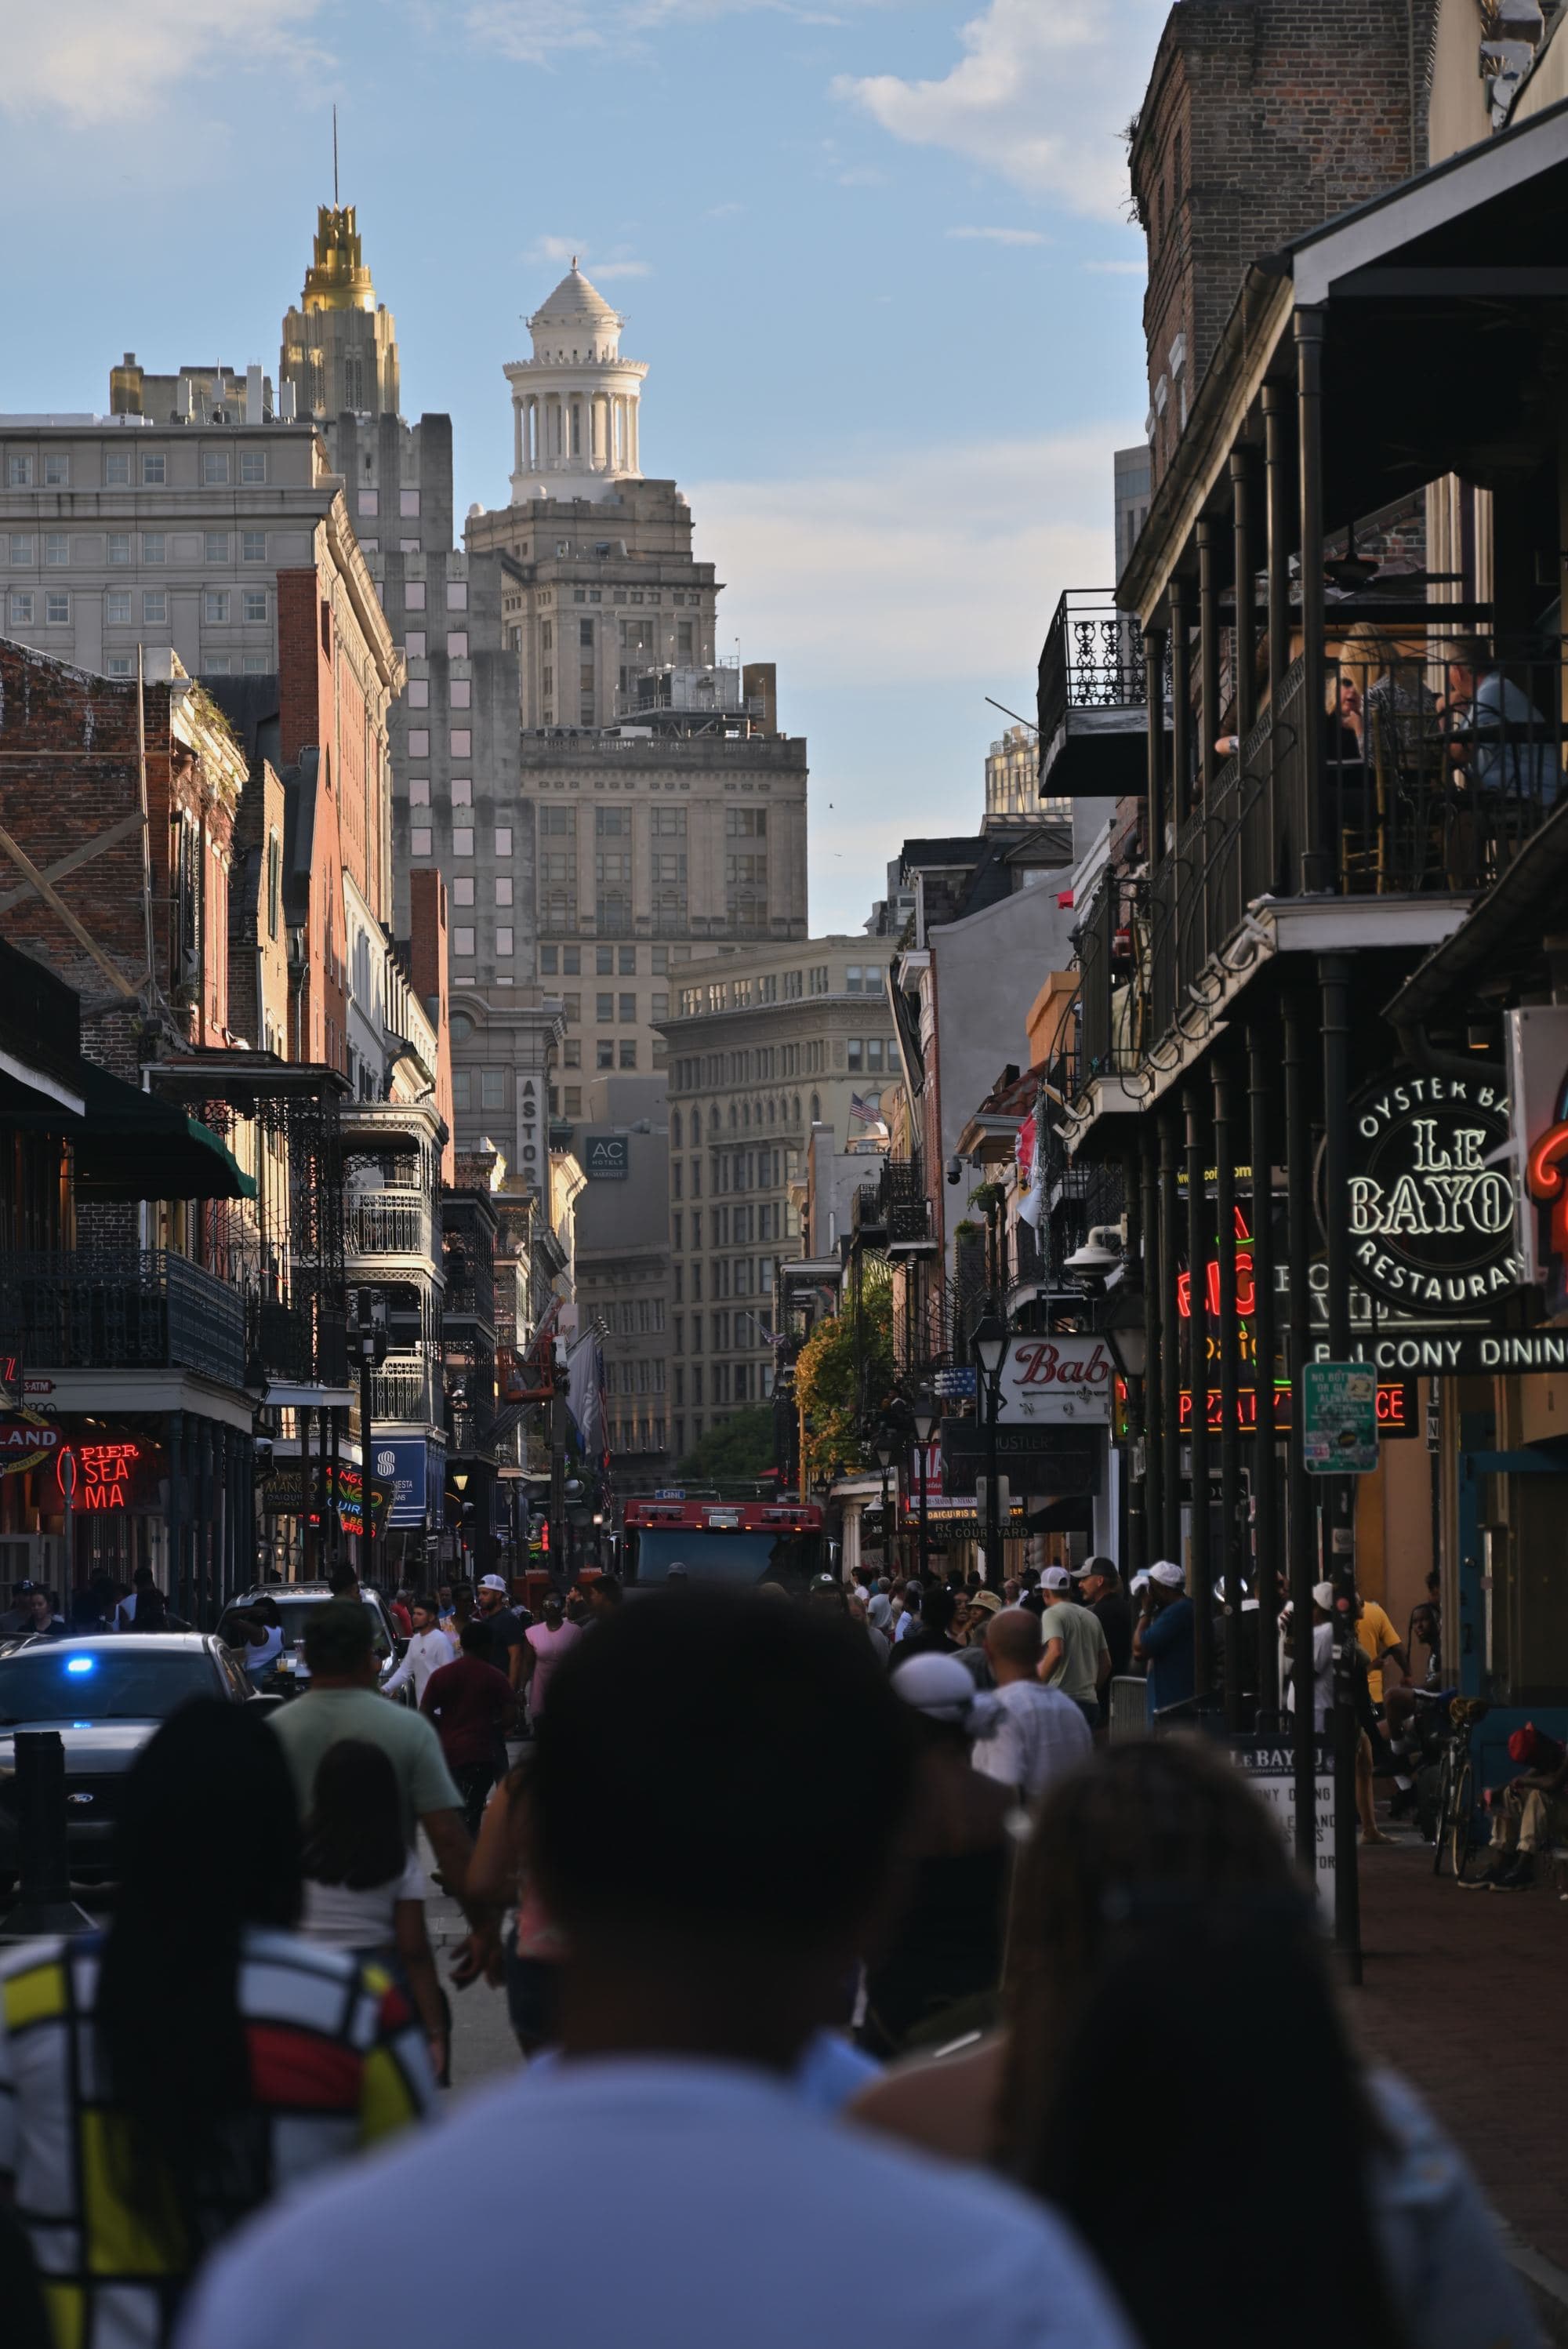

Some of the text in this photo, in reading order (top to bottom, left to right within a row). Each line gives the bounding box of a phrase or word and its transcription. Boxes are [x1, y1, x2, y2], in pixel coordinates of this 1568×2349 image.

[592, 1142, 623, 1158] AC
[1411, 1119, 1486, 1171] LE
[1348, 1171, 1515, 1234] BAYO
[1356, 1239, 1525, 1302] RESTAURAN
[1012, 1343, 1109, 1385] Bab
[1480, 1338, 1568, 1366] DININ
[80, 1444, 140, 1461] PIER
[84, 1458, 129, 1483] SEA
[85, 1484, 125, 1509] MA
